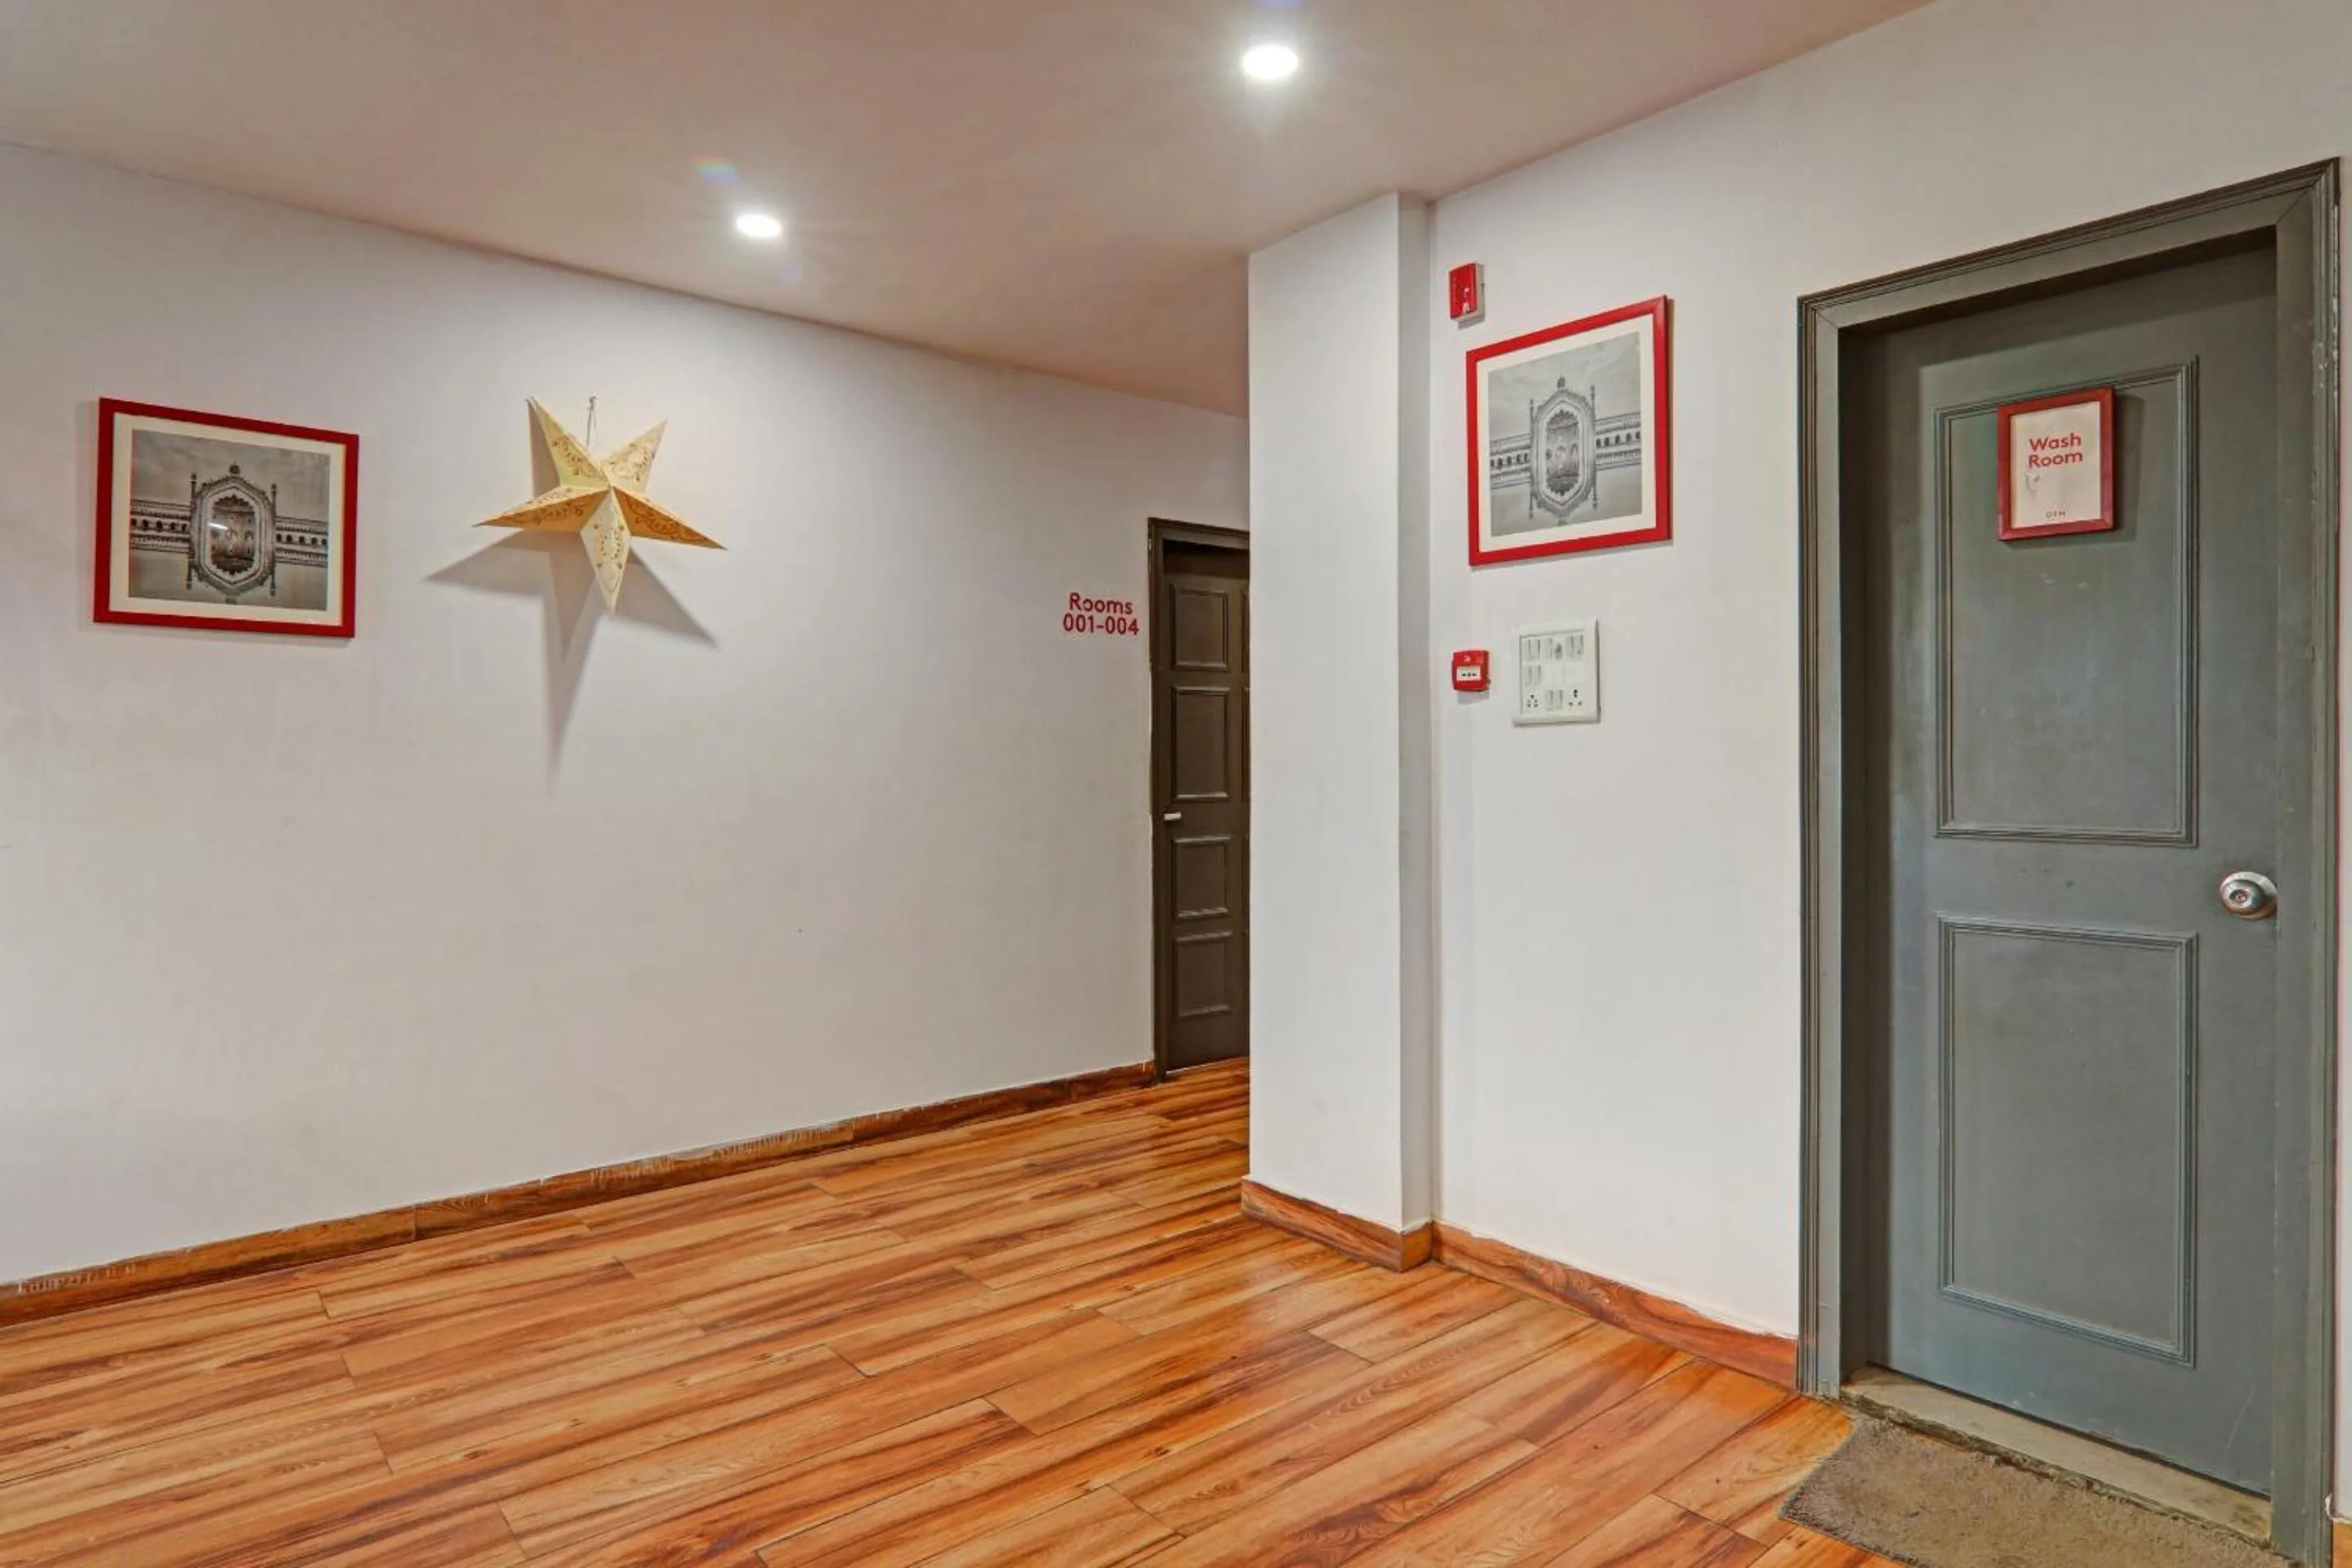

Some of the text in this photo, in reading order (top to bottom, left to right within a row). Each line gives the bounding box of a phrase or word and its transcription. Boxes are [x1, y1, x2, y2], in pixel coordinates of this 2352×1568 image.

[2029, 432, 2081, 452] Wash
[2029, 452, 2082, 469] Room
[1069, 592, 1133, 615] Rooms
[1063, 613, 1139, 635] 001-004
